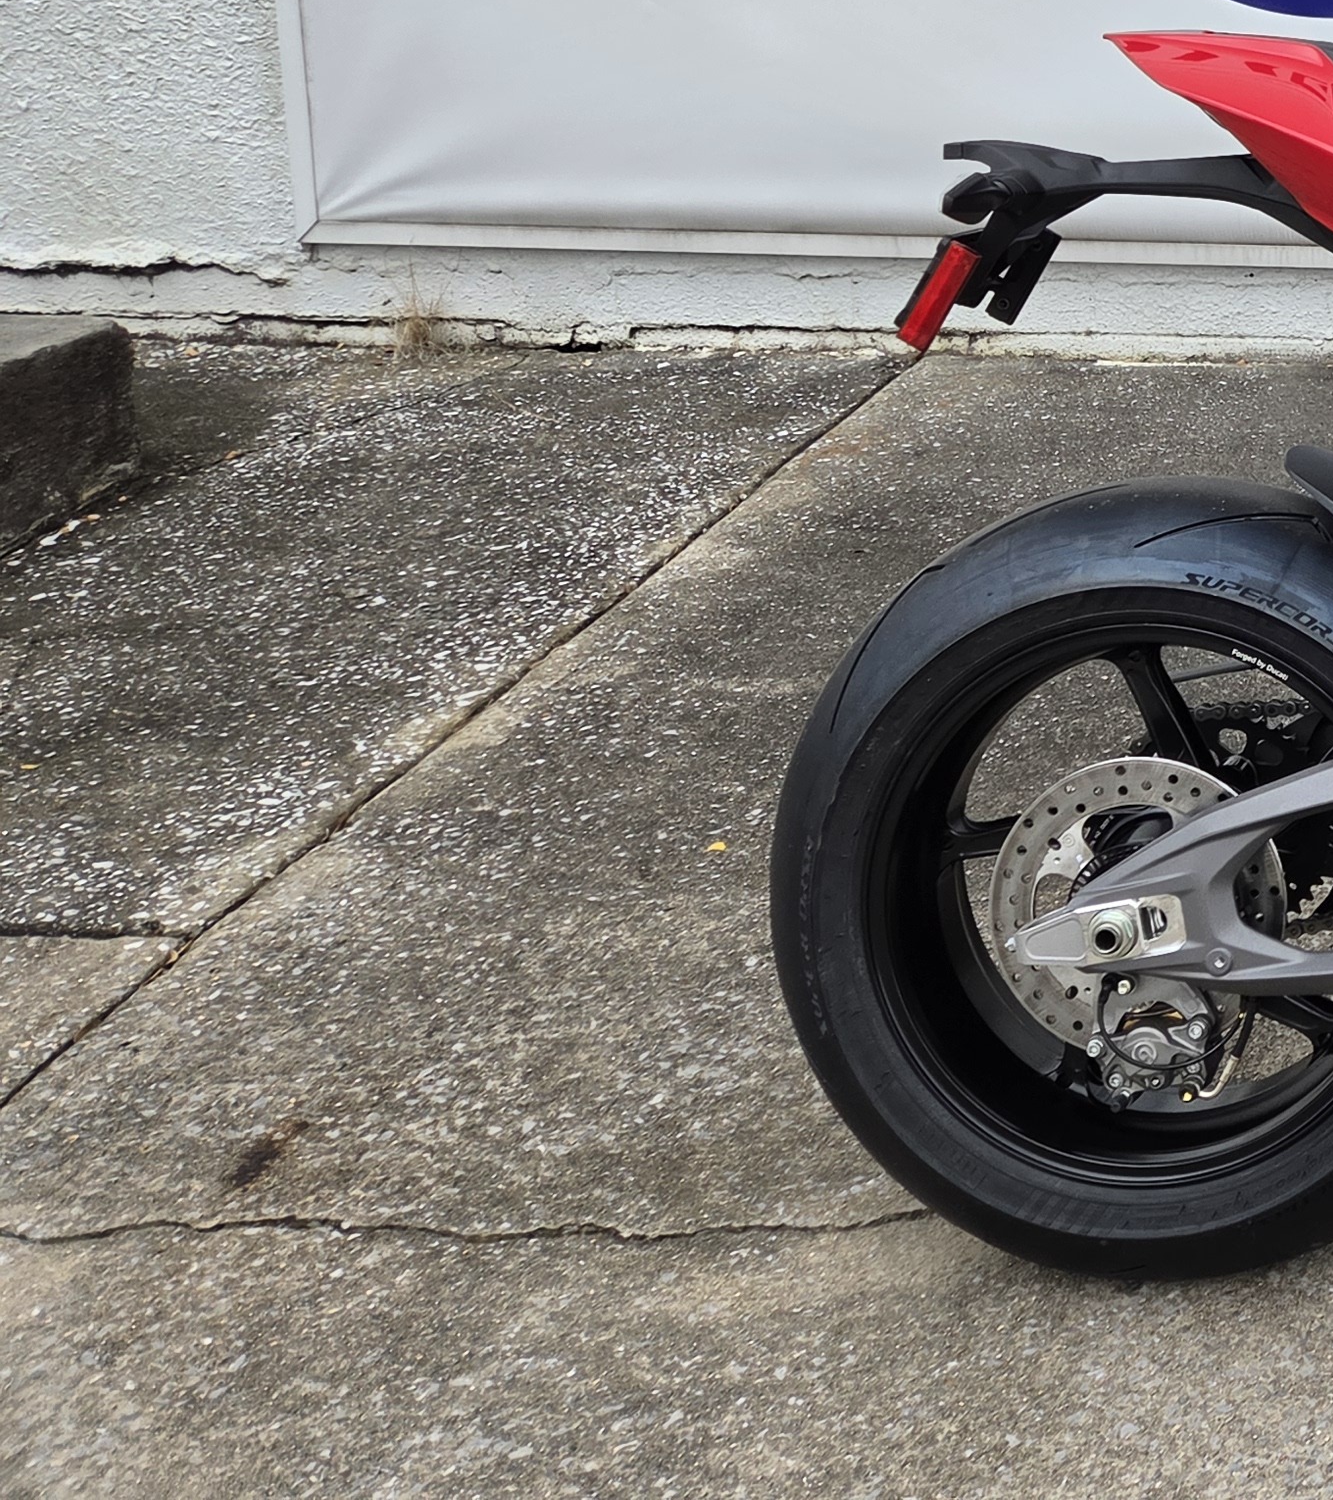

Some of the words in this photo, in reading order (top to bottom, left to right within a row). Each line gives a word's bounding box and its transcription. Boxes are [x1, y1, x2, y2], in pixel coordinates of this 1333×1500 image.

[1231, 648, 1258, 665] Forged
[1256, 659, 1267, 670] by
[1266, 663, 1290, 681] Ducati
